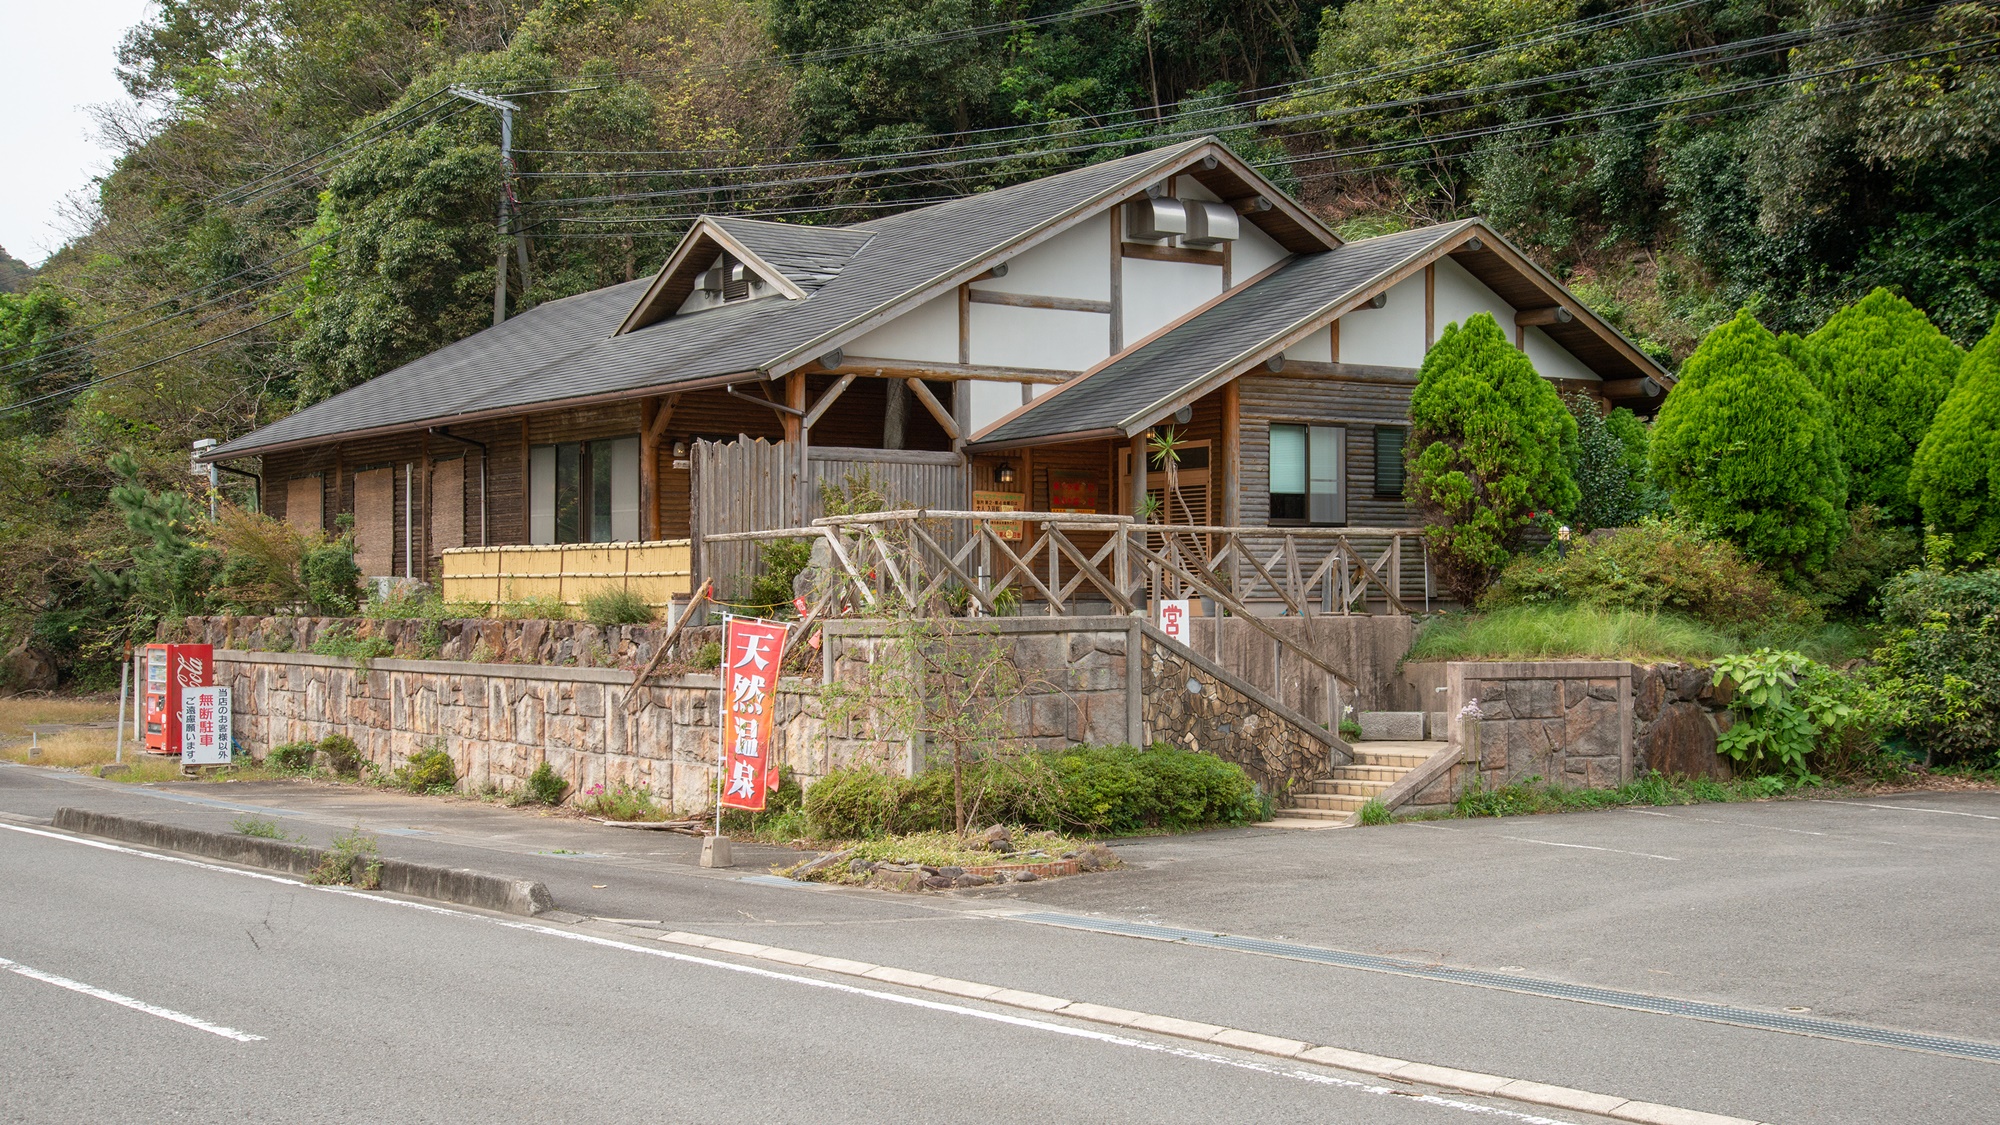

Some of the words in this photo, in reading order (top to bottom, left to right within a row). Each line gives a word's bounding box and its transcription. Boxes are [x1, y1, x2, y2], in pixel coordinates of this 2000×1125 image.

[199, 694, 213, 747] 無断駐車
[218, 689, 228, 759] 当店のお客様以外
[728, 633, 774, 799] 天然温泉
